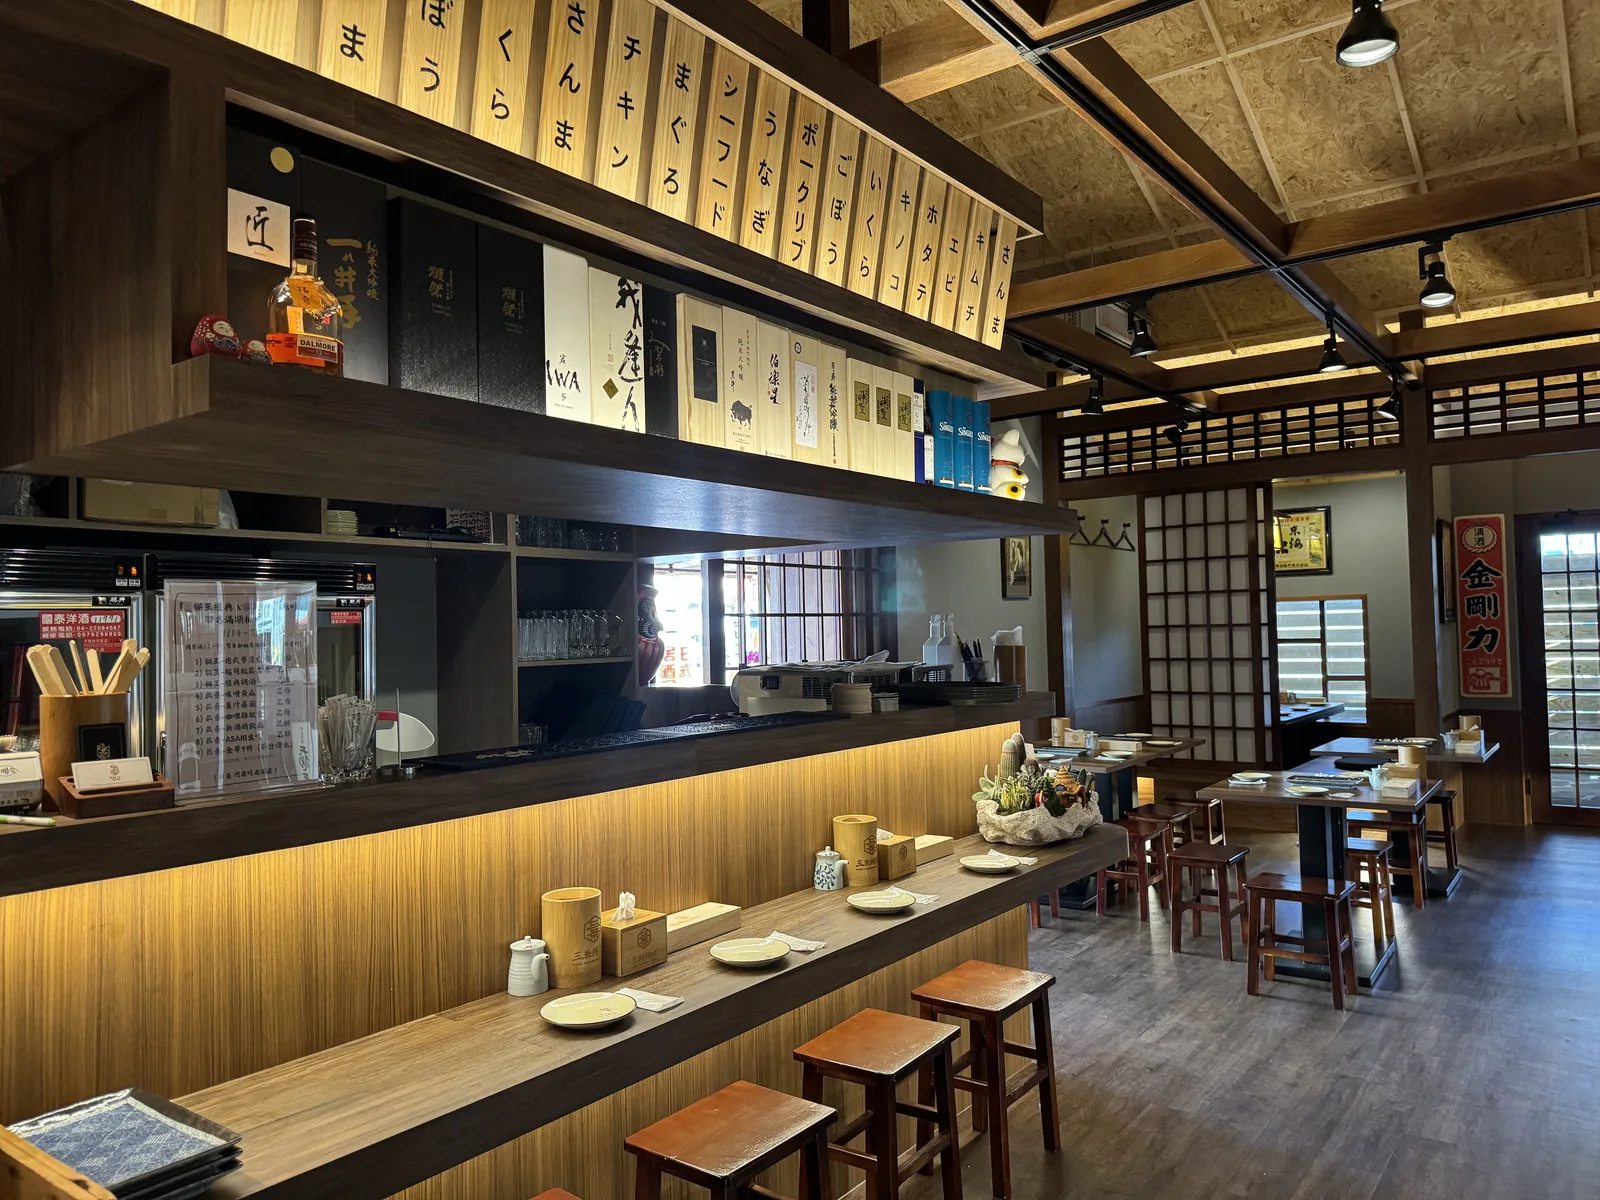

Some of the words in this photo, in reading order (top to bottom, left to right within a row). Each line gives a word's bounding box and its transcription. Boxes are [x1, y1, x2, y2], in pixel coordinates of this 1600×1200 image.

[491, 28, 515, 120] くら
[553, 3, 587, 151] さんま
[611, 36, 642, 169] チキン
[663, 62, 692, 195] まぐろ
[711, 75, 738, 228] シーフード
[752, 110, 777, 234] うなぎ
[246, 206, 274, 252] 匠
[791, 123, 819, 262] ポークリブ
[827, 154, 852, 265] ごぼう
[860, 170, 882, 278] いくら
[890, 190, 911, 291] キノコ
[916, 204, 938, 301] ホタテ
[945, 237, 959, 294] エビ
[965, 231, 985, 322] キムチ
[991, 245, 1011, 334] さんま
[300, 339, 336, 352] DALMORE
[546, 359, 581, 393] IWA
[1474, 528, 1485, 547] 清酒
[41, 613, 89, 625] 國泰洋酒
[1460, 558, 1502, 655] 金剛力
